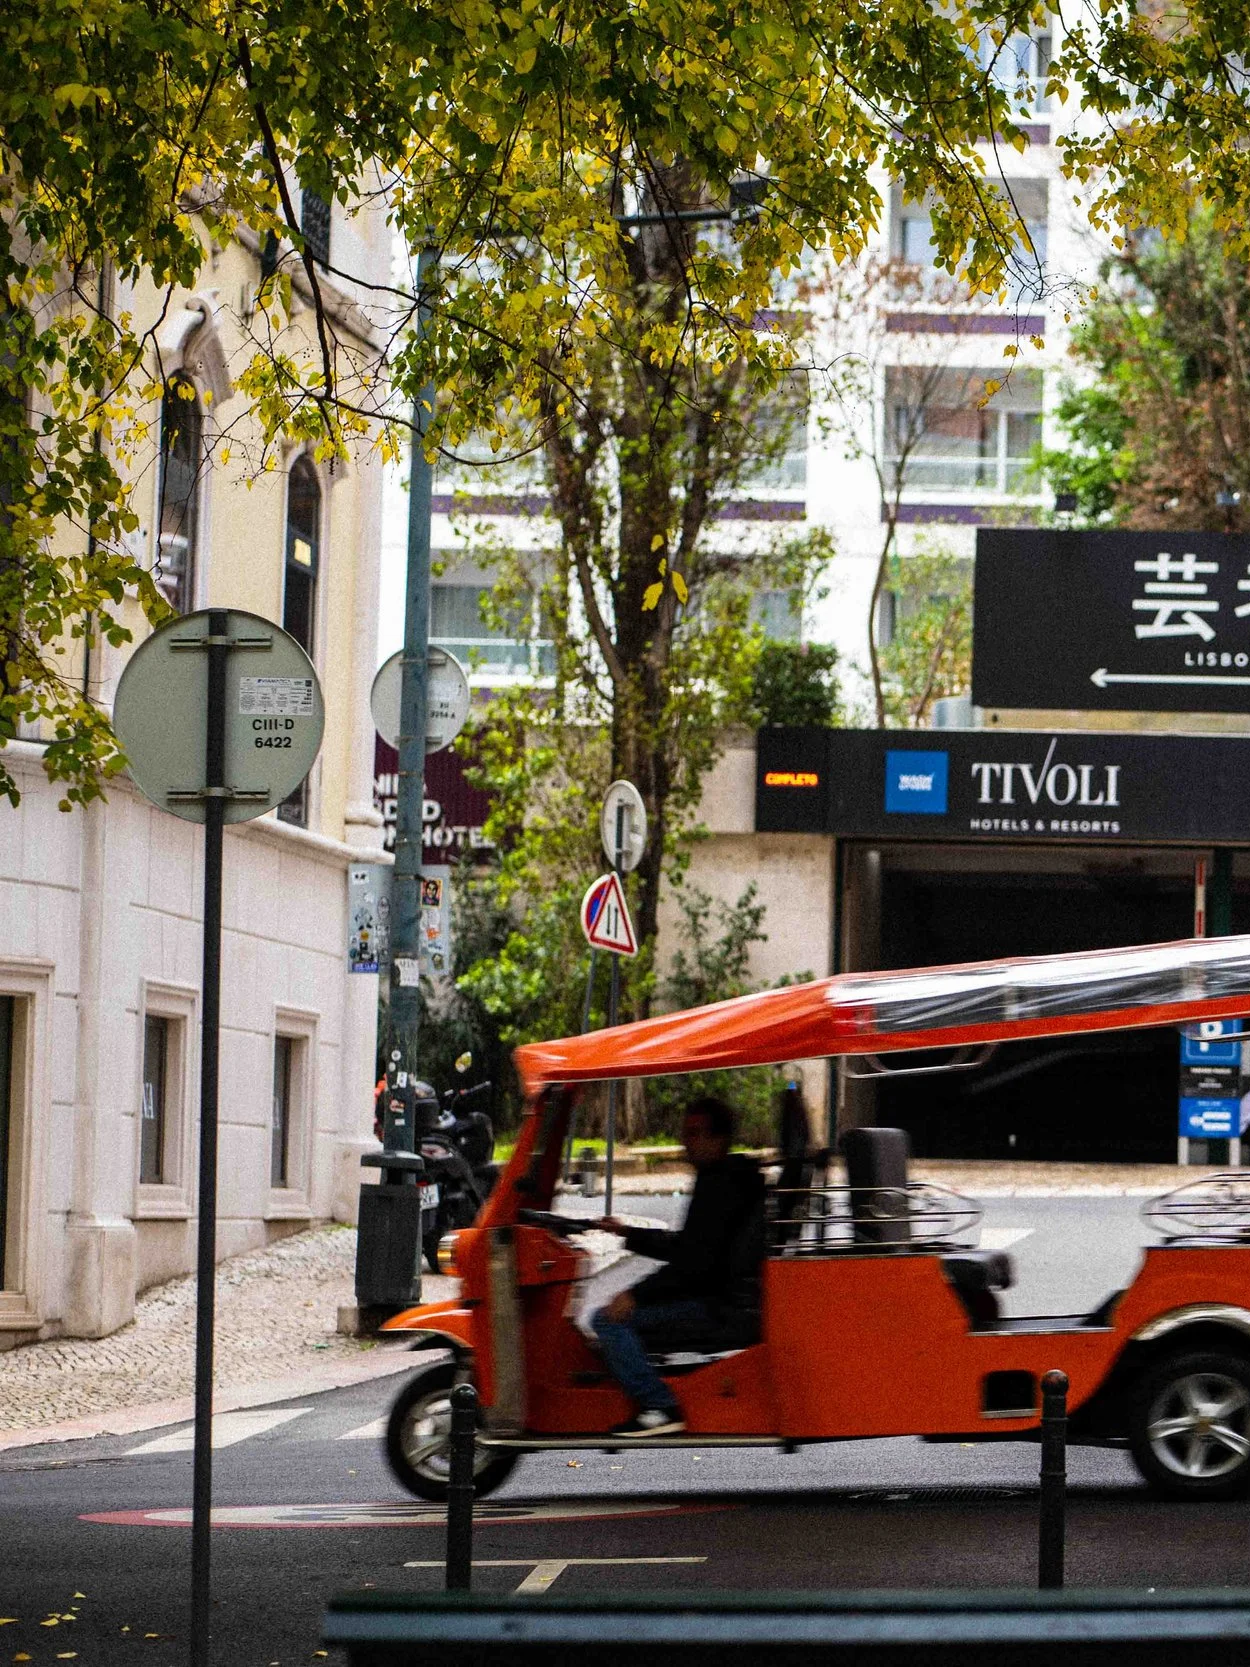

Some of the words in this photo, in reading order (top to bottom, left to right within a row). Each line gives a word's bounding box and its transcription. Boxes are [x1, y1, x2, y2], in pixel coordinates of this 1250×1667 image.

[252, 718, 295, 731] CIII-D
[255, 737, 292, 749] 6422
[971, 737, 1122, 807] TIVOLI
[970, 818, 1030, 833] HOTELS
[1034, 819, 1046, 833] &
[1050, 819, 1121, 834] RESORTS
